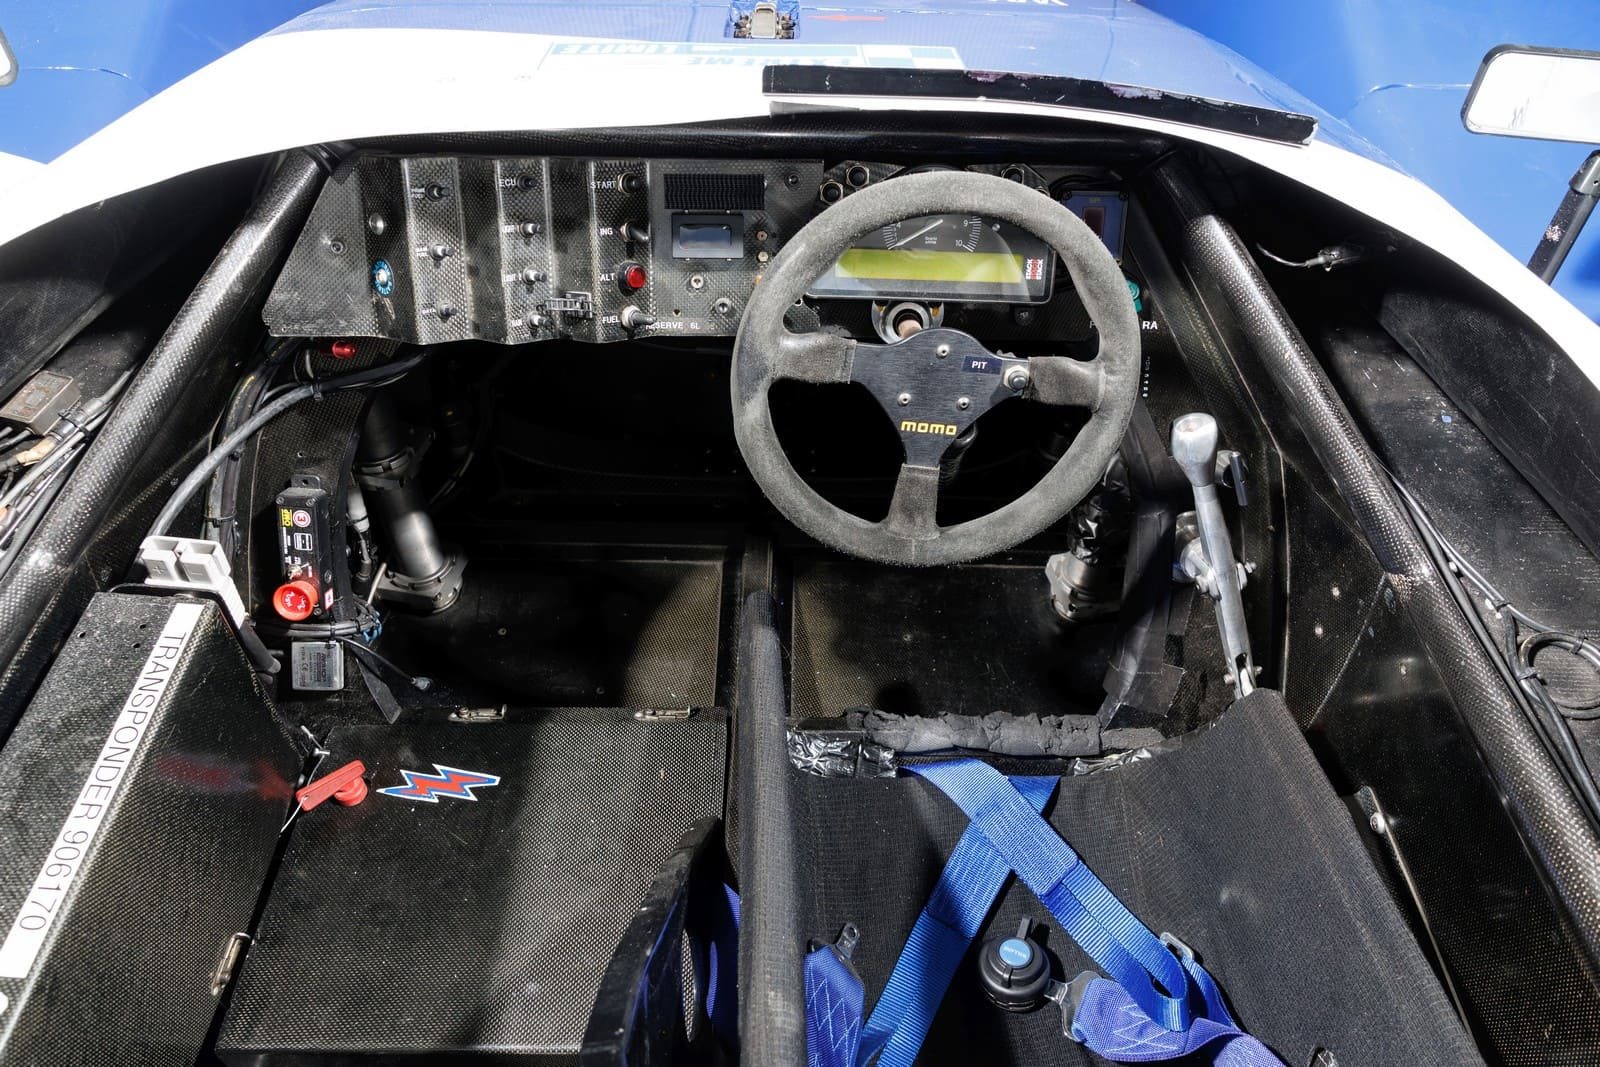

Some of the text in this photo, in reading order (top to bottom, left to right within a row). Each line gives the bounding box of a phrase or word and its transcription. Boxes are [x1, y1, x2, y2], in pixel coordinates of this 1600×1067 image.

[499, 179, 516, 187] ECU
[590, 181, 617, 189] START
[599, 273, 615, 281] ALT
[602, 315, 621, 324] FUEL
[971, 360, 988, 370] PIT
[20, 631, 187, 931] TRANSPONDER 906170
